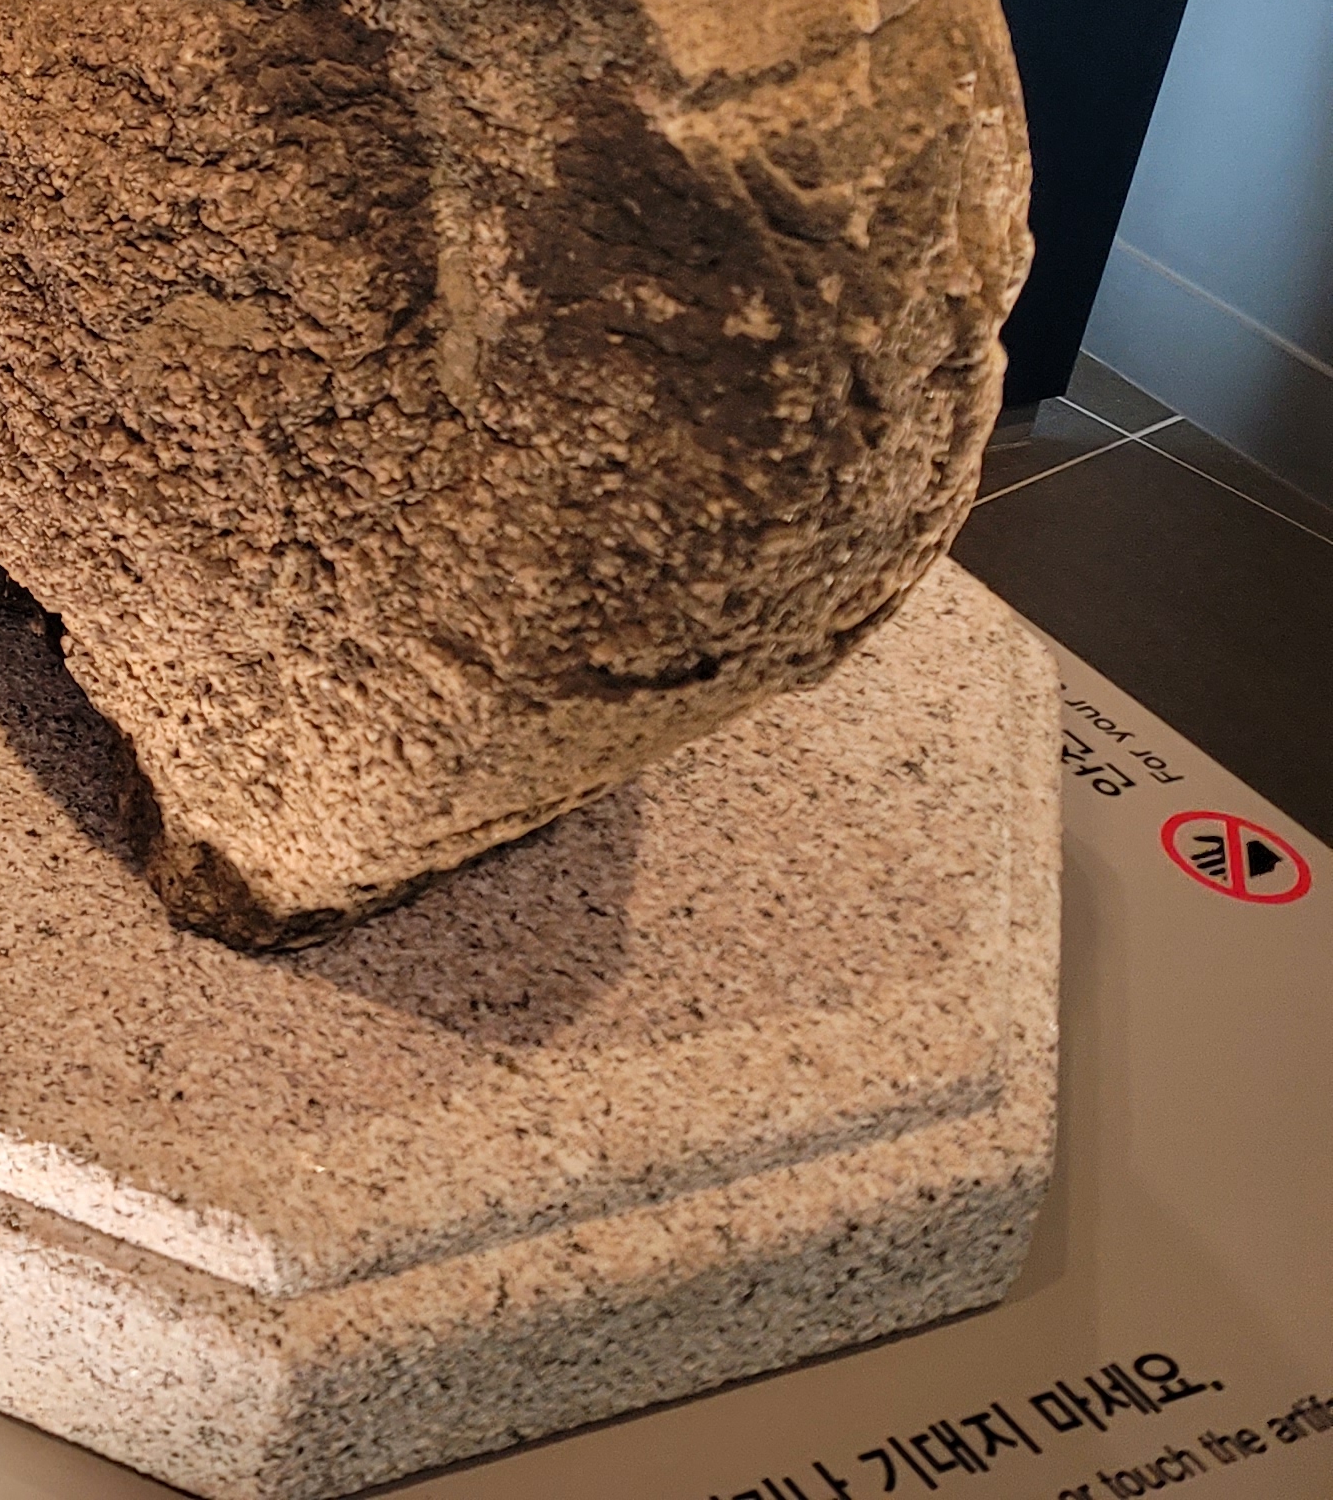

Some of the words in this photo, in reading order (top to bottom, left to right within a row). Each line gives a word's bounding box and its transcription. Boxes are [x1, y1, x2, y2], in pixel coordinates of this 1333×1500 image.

[1064, 699, 1135, 743] your
[1129, 750, 1184, 785] For
[858, 1402, 1043, 1492] 기대지
[1029, 1353, 1225, 1432] 마세요.
[1096, 1445, 1208, 1500] touch
[1198, 1430, 1268, 1465] the
